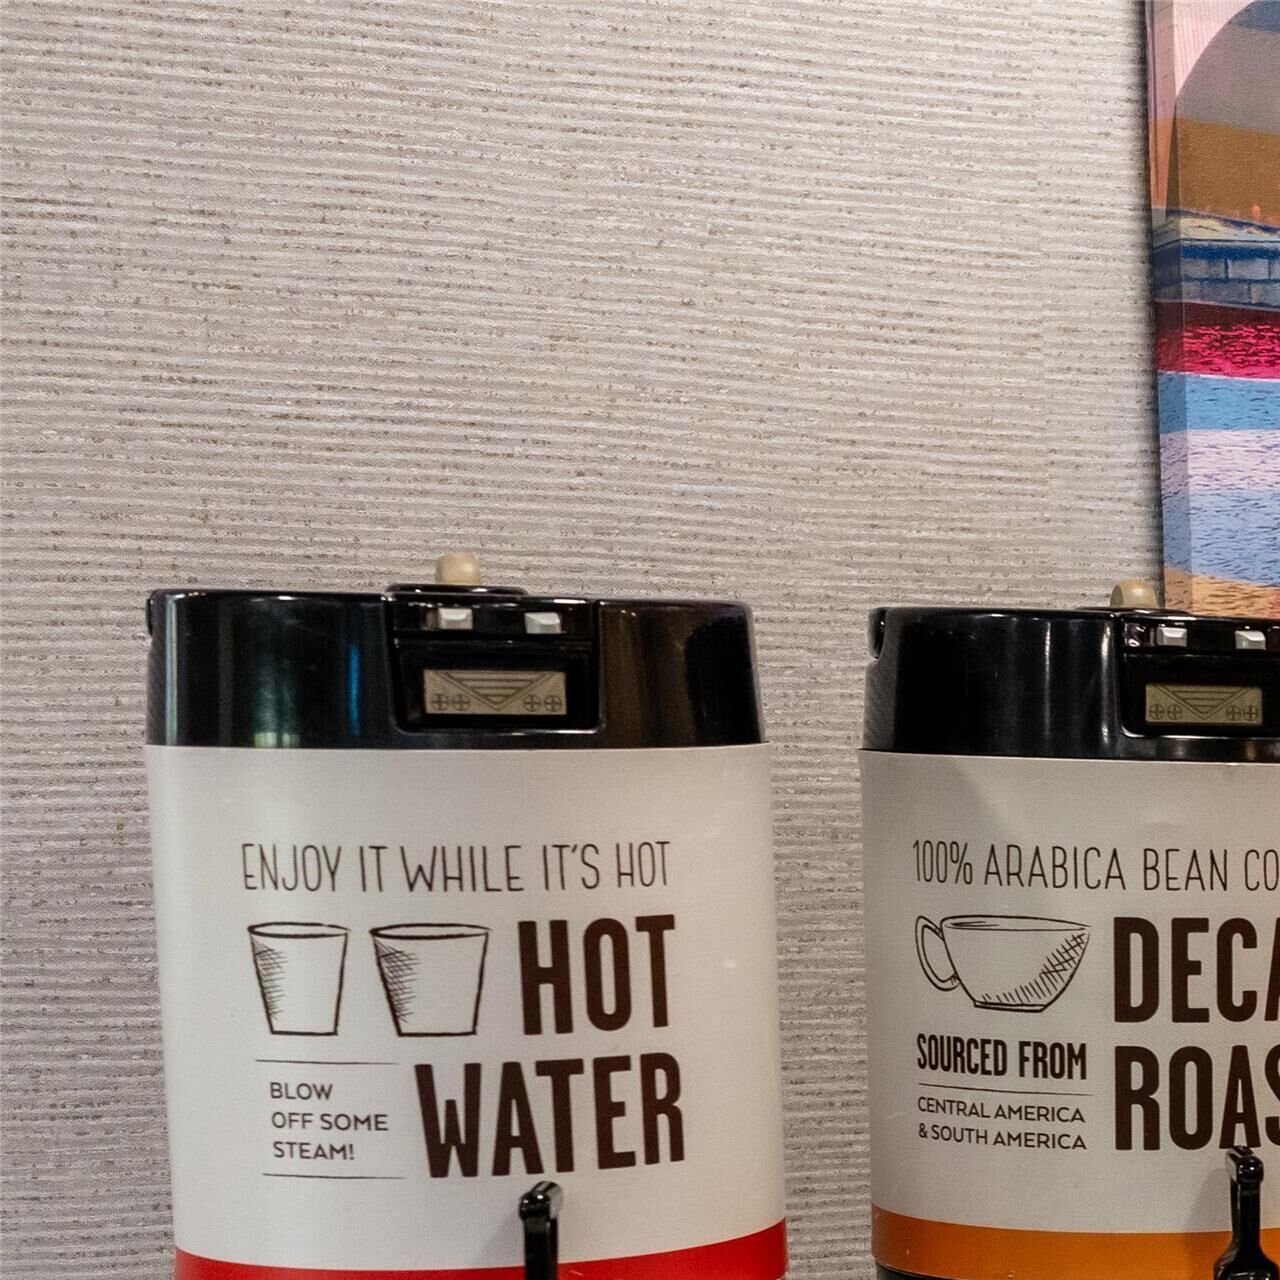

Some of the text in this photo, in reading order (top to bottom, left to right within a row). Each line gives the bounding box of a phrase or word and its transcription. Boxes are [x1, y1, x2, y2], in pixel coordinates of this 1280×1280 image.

[241, 840, 671, 893] ENJOY IT WHILE IT'S HOT
[912, 839, 973, 885] 100%
[983, 843, 1127, 891] ARABICA
[1143, 847, 1228, 892] BEAN
[517, 913, 676, 1036] HOT
[916, 1032, 1087, 1081] SOURCED FROM
[269, 1081, 333, 1101] BLOW
[917, 1096, 1086, 1123] CENTRAL AMERICA
[271, 1111, 389, 1132] OFF SOME
[413, 1052, 685, 1179] WATER
[273, 1140, 355, 1161] STEAM!
[918, 1122, 1087, 1150] & SOUTH AMERICA
